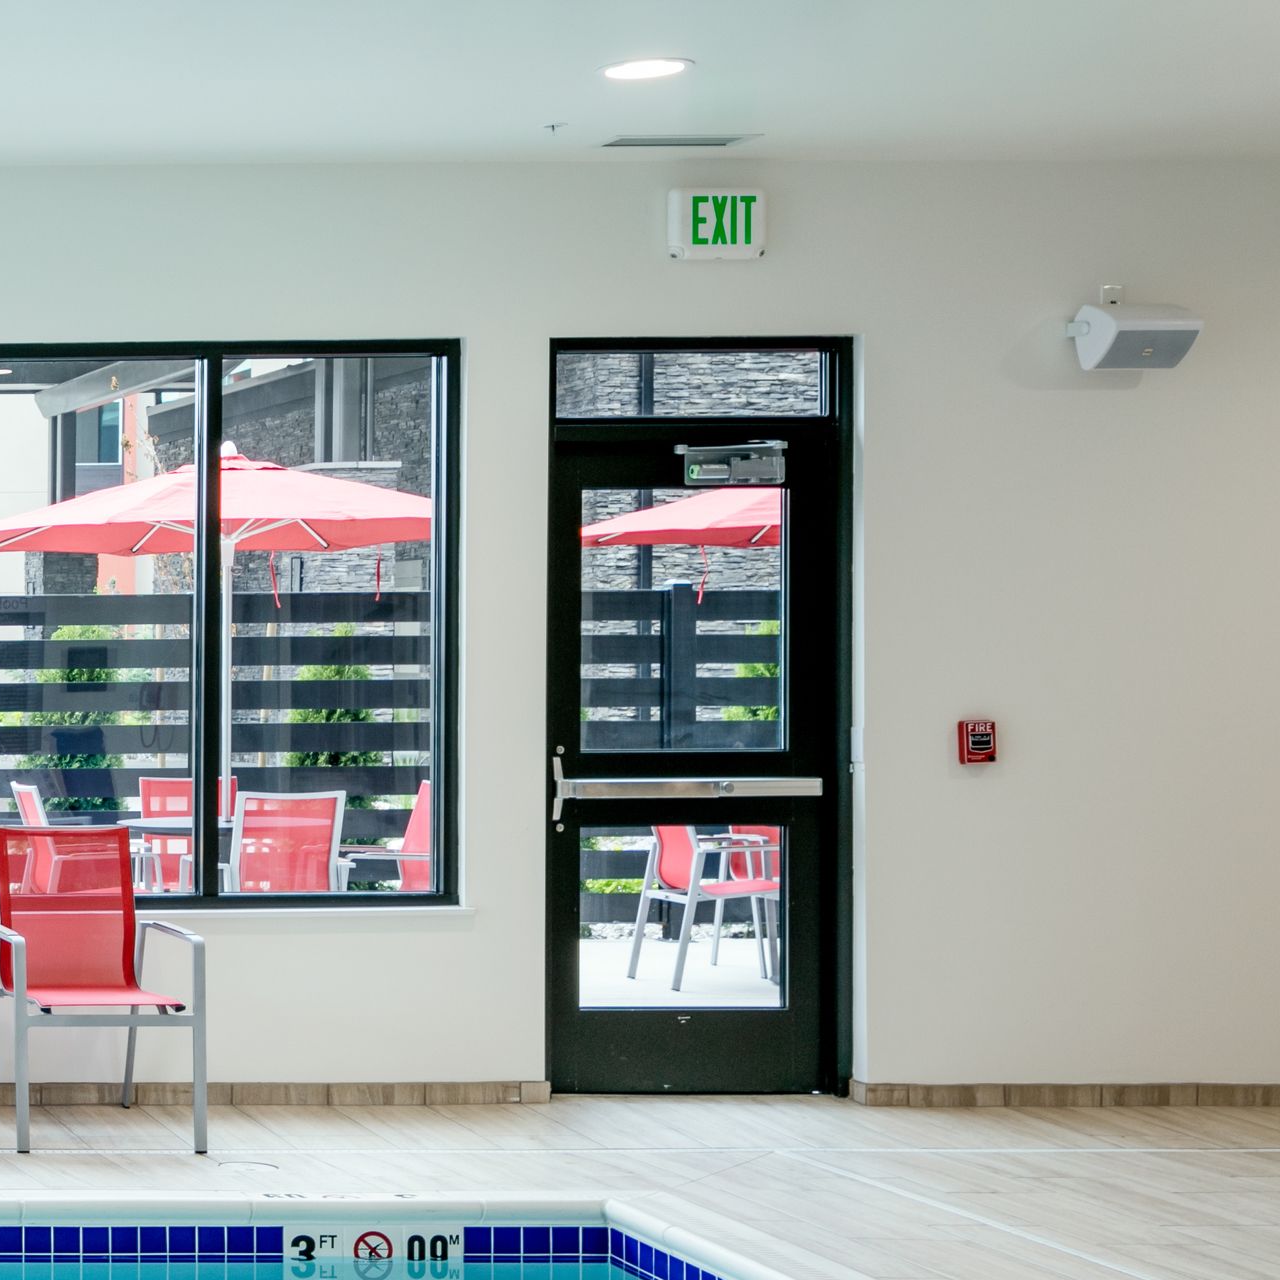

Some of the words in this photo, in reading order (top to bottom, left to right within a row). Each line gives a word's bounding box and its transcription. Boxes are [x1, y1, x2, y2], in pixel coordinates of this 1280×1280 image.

[692, 195, 757, 245] EXIT
[967, 723, 993, 732] FIRE
[291, 1235, 316, 1261] 3
[319, 1235, 338, 1249] FT
